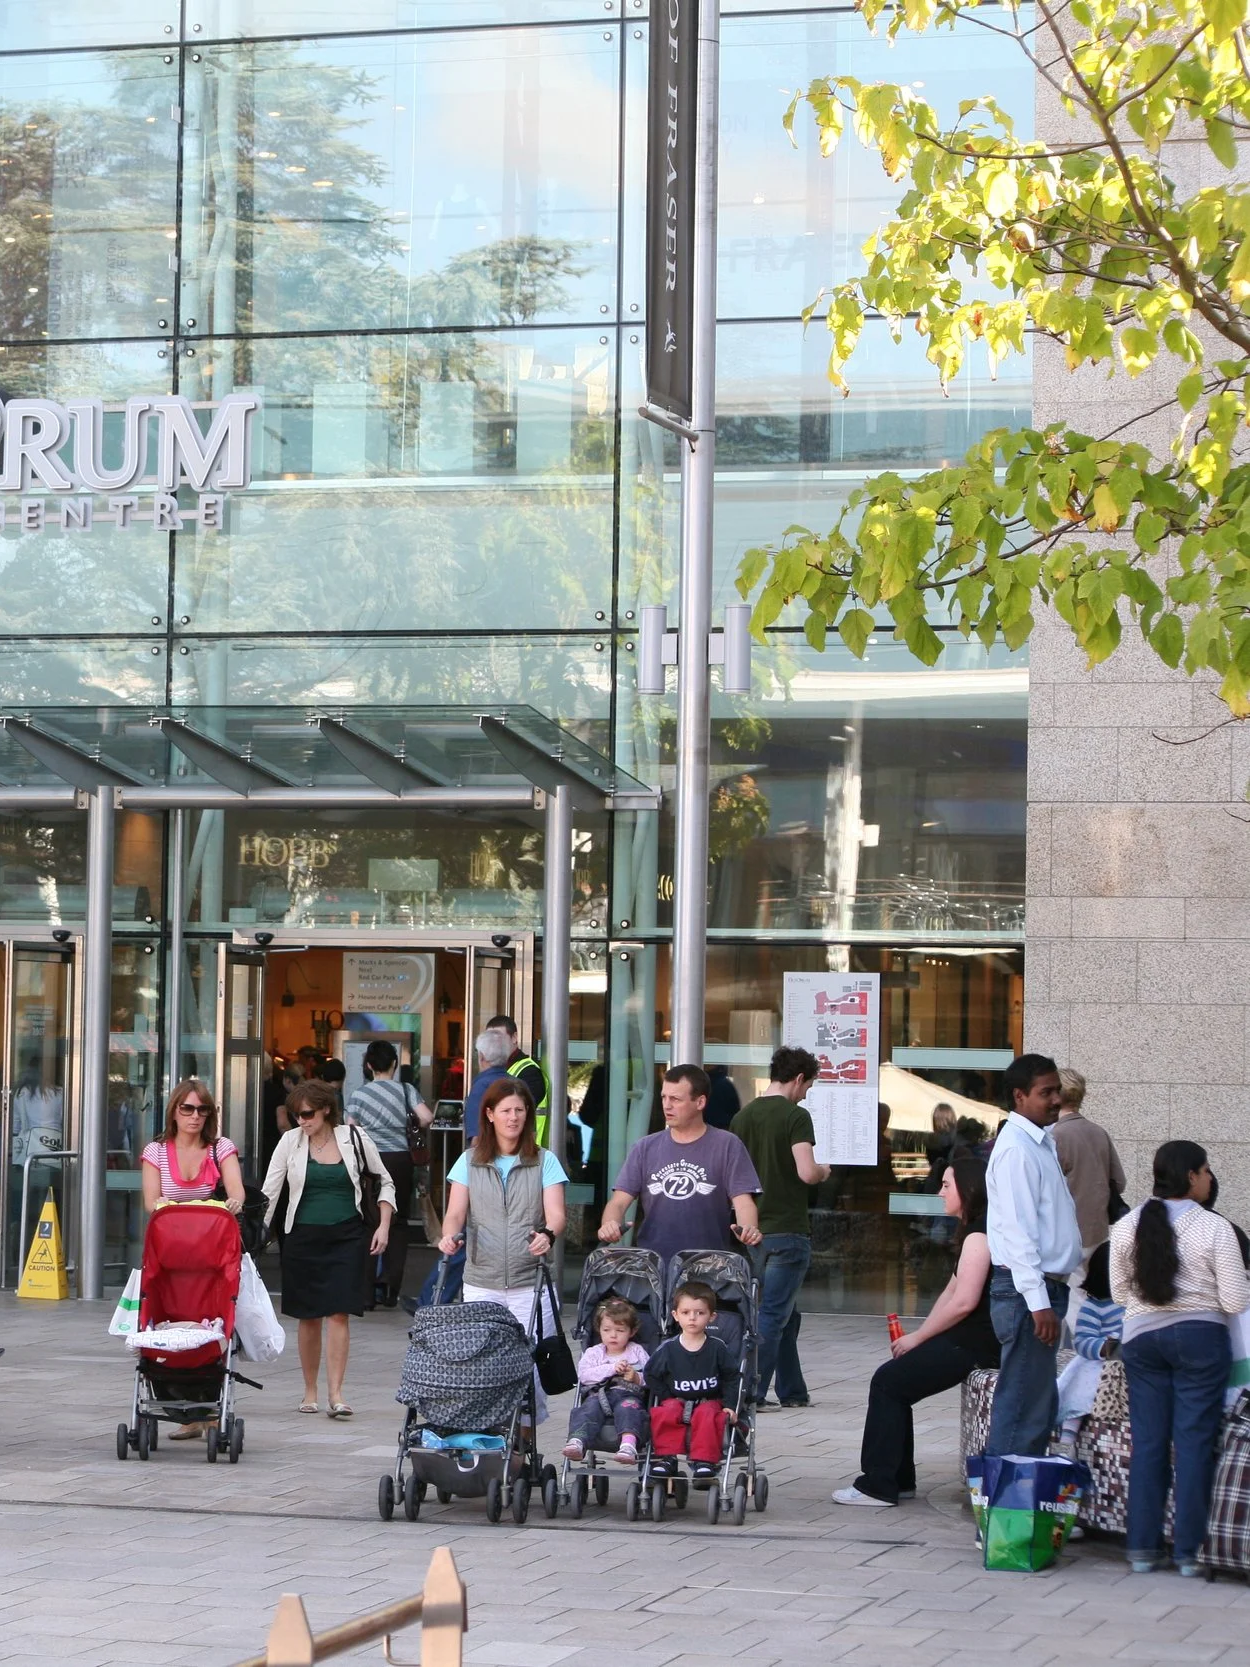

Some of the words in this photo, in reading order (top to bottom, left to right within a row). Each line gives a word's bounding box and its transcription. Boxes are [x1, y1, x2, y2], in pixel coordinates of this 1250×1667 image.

[665, 80, 678, 292] FRASER
[668, 1176, 690, 1195] 72
[28, 1264, 55, 1272] CAUTION
[674, 1376, 718, 1392] Levi's
